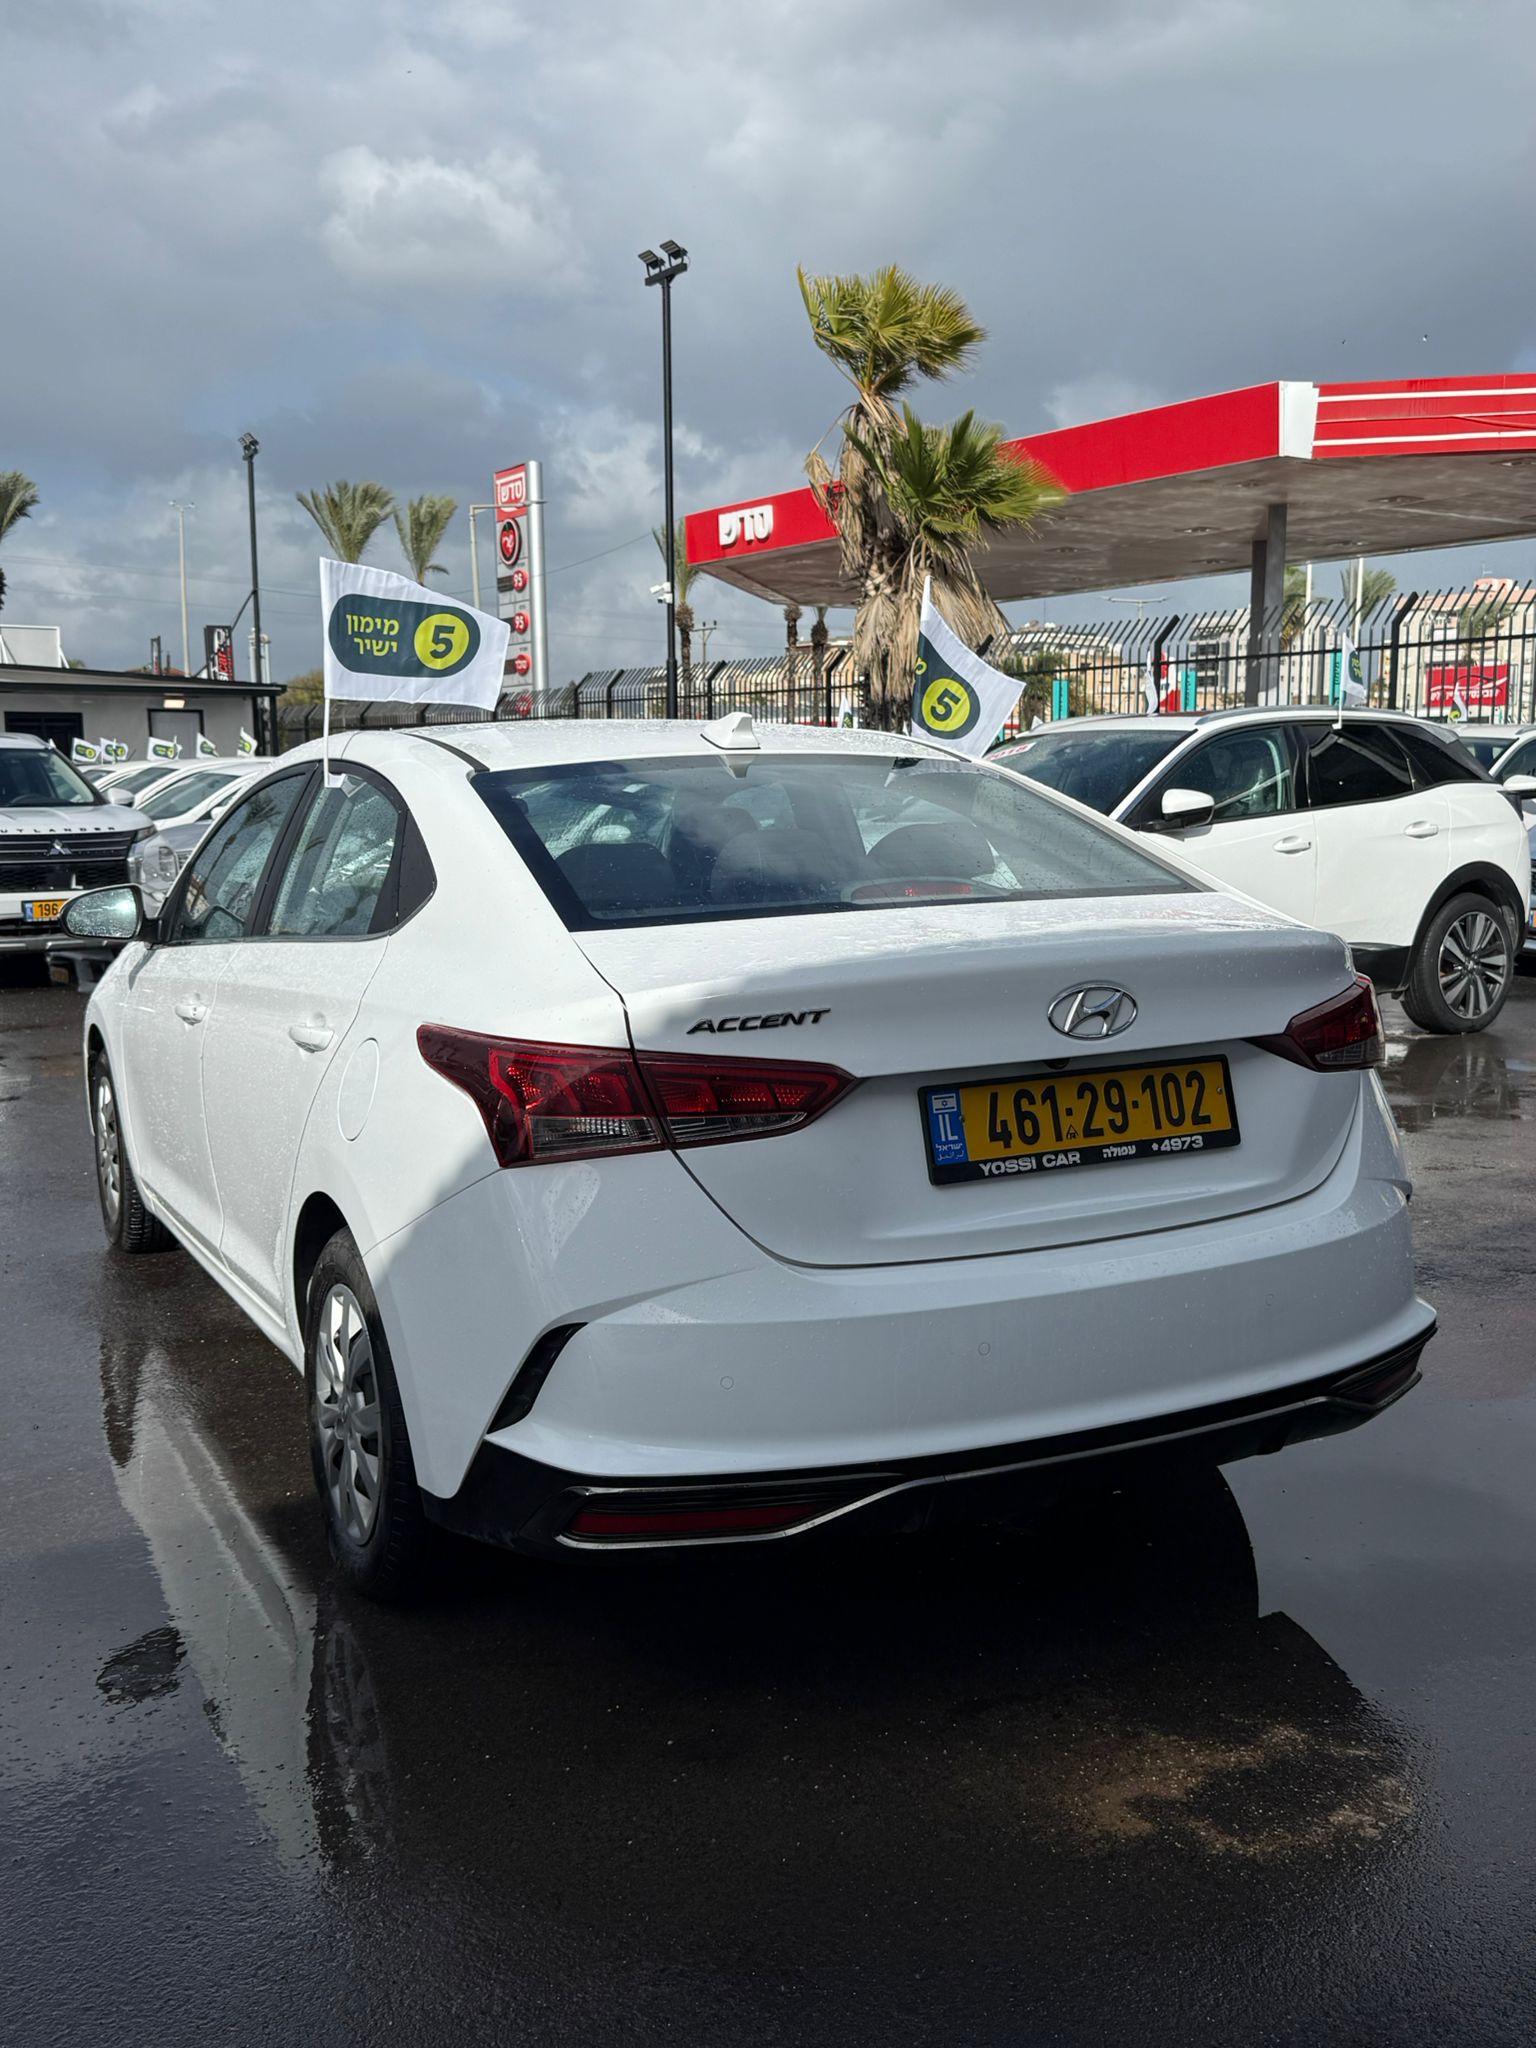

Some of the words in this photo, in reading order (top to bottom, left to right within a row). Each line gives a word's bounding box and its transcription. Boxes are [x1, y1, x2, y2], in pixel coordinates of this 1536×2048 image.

[346, 613, 400, 636] מימון
[353, 636, 398, 656] ישיר
[429, 624, 456, 660] 5
[930, 688, 961, 721] 5
[38, 903, 58, 917] 196
[686, 1008, 832, 1035] ACCENT
[938, 1114, 959, 1141] IL
[979, 1157, 1037, 1176] YOSSI
[1042, 1151, 1081, 1168] CAR
[1102, 1145, 1136, 1159] עפולה
